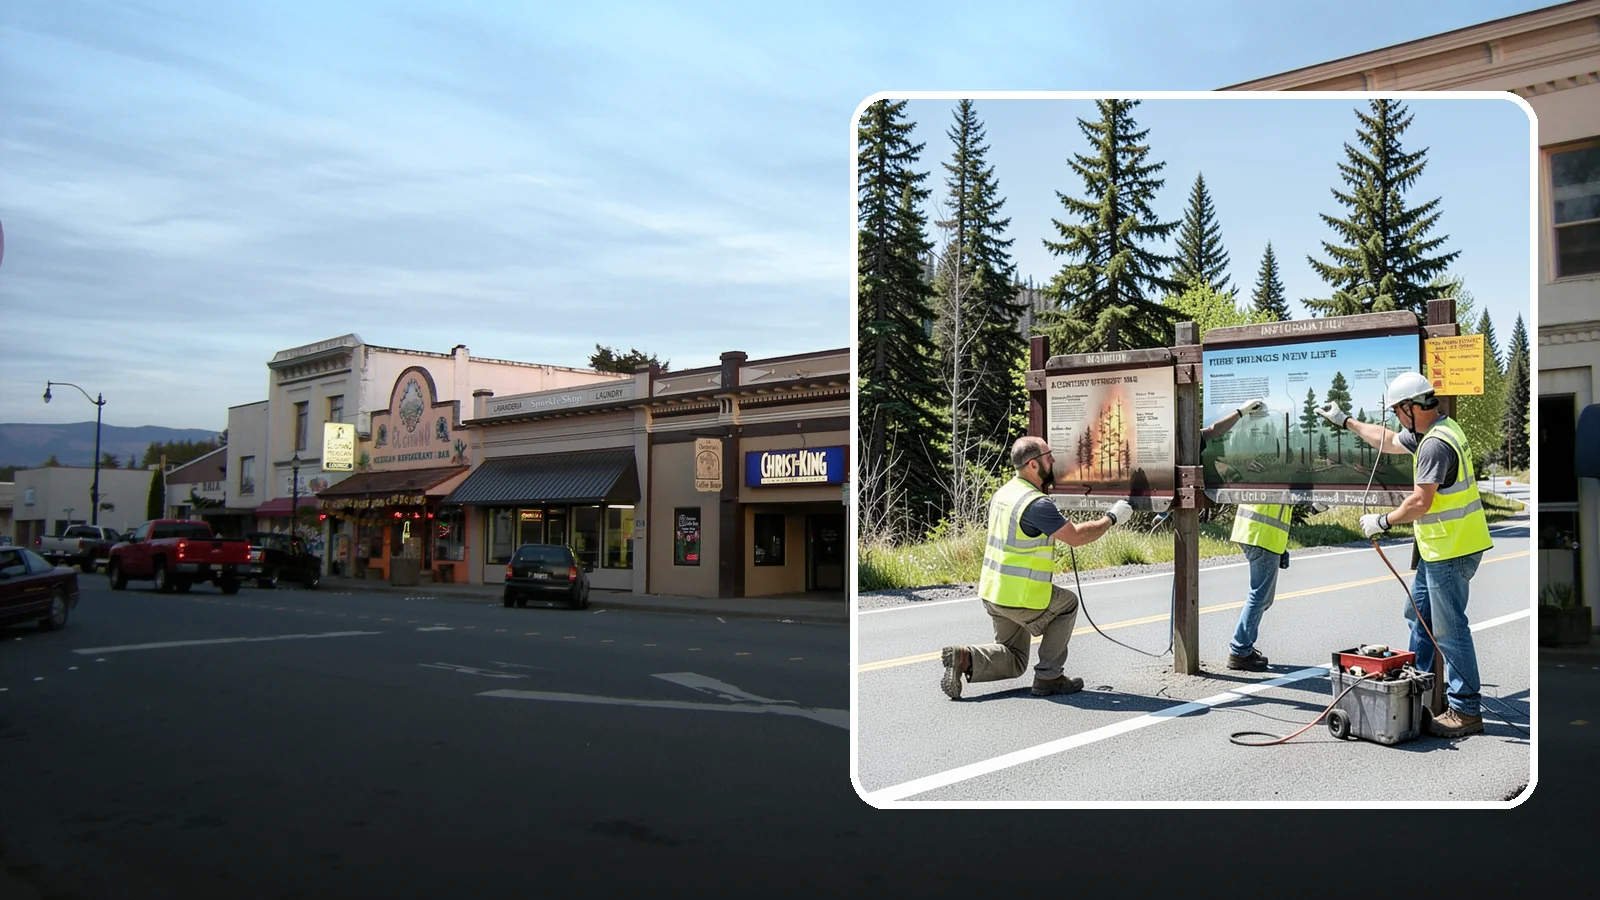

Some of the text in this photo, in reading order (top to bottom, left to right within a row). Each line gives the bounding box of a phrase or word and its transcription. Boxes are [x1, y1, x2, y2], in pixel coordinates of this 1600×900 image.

[493, 401, 523, 412] LAVANDERIA
[561, 395, 583, 405] Shop
[596, 389, 624, 400] LAUNDRY
[398, 451, 434, 462] RESTAURANT
[438, 450, 450, 459] BAR
[761, 450, 827, 477] CHRIST KING
